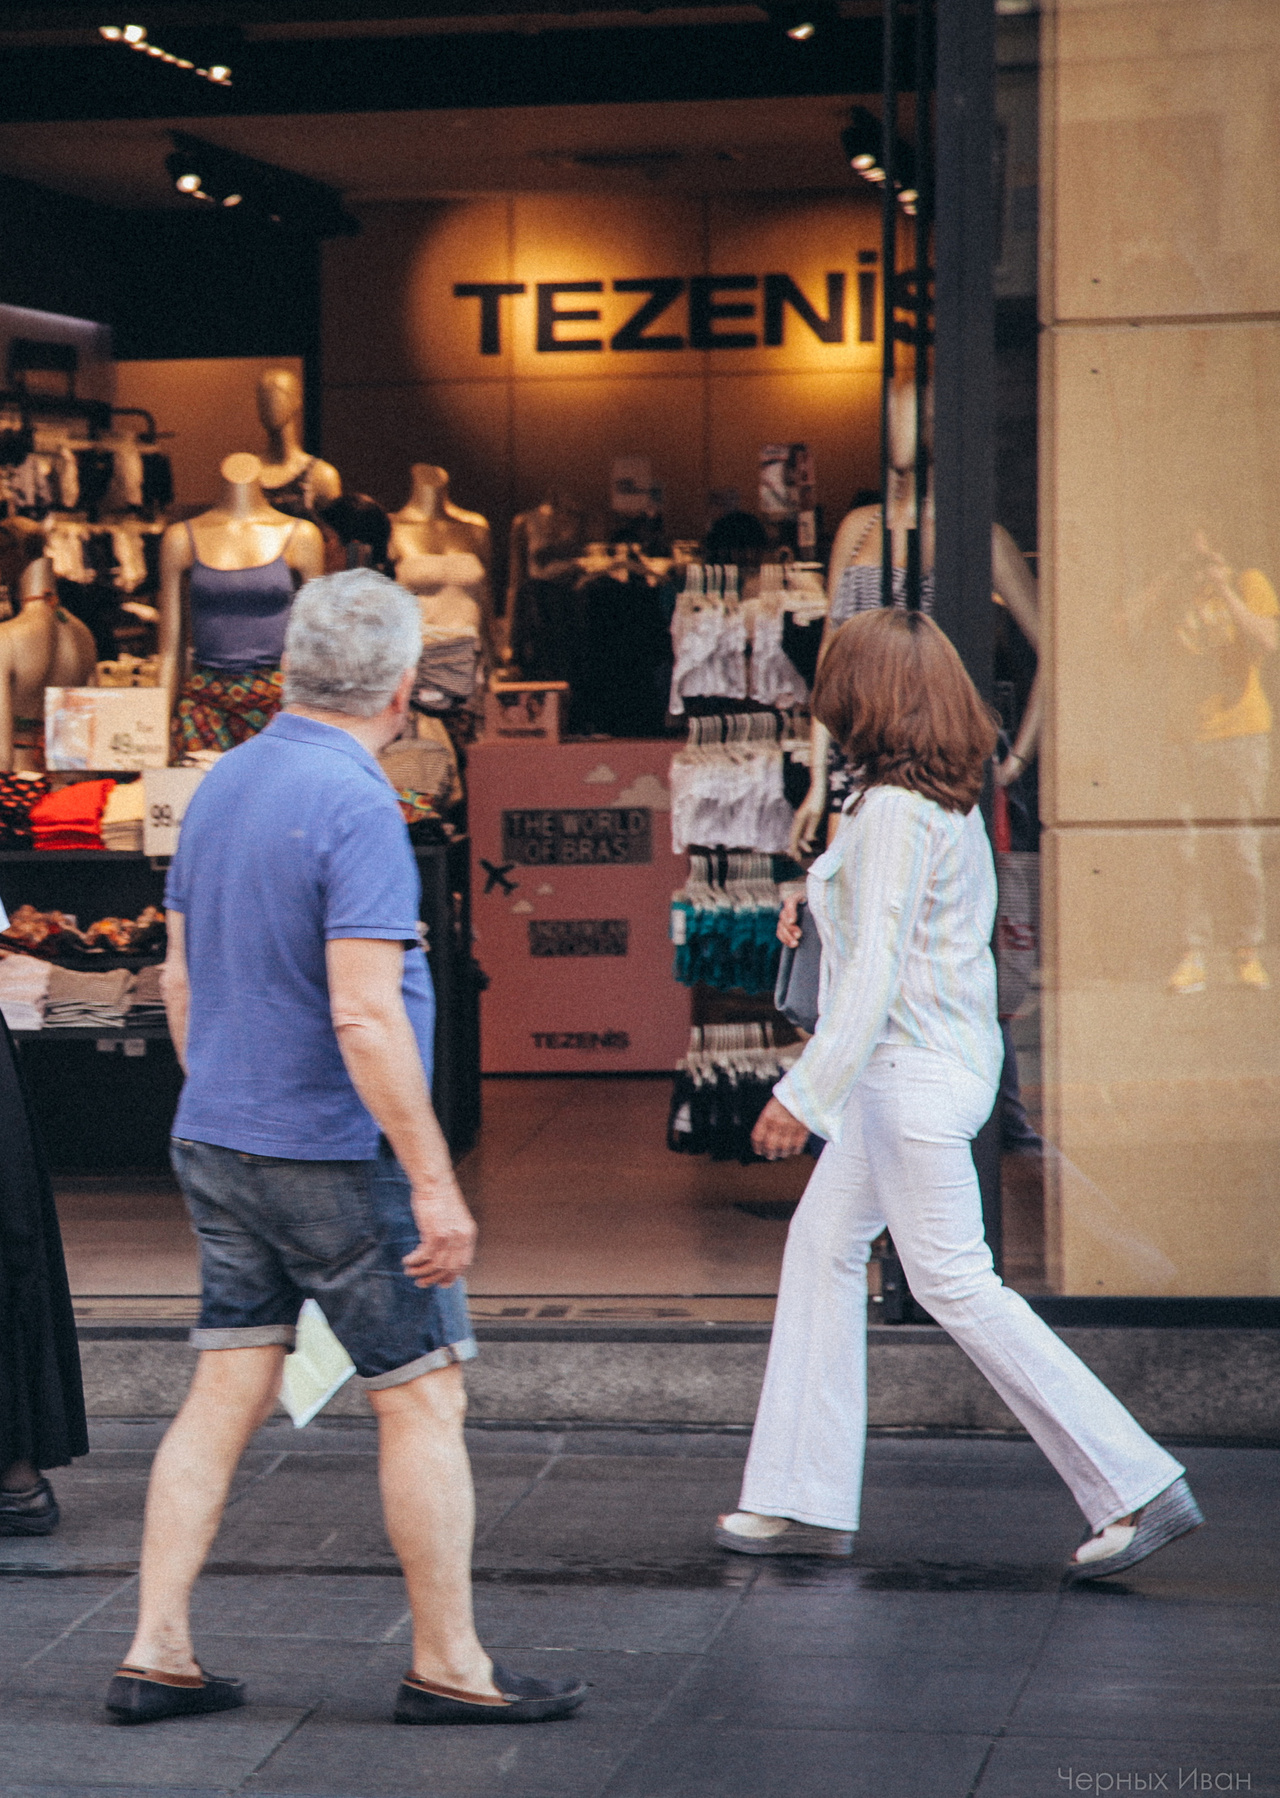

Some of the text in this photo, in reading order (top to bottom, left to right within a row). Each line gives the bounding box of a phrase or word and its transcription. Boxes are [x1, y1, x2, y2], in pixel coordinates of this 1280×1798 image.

[511, 811, 646, 836] THE WORLD
[525, 838, 628, 862] OF BRAS
